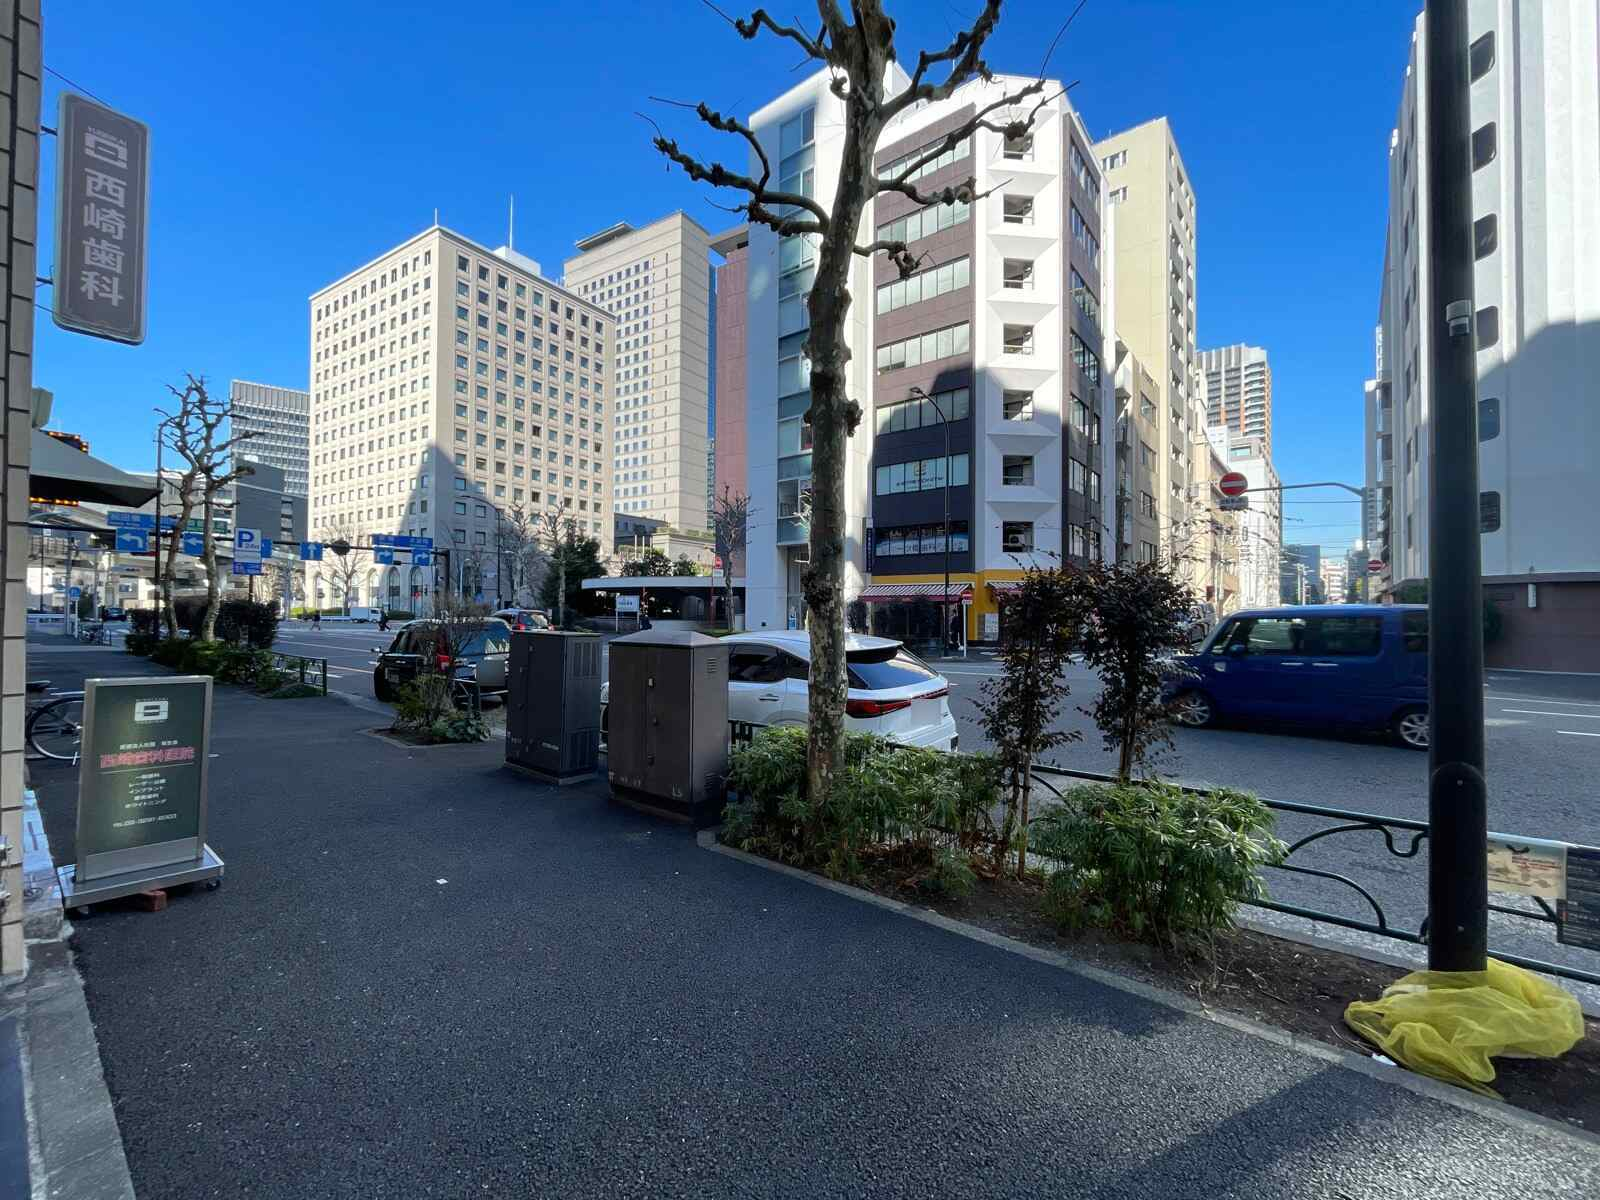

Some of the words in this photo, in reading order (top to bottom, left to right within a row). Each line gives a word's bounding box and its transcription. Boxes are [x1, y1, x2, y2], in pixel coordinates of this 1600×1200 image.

[80, 167, 127, 307] 西崎歯科
[238, 531, 254, 547] P
